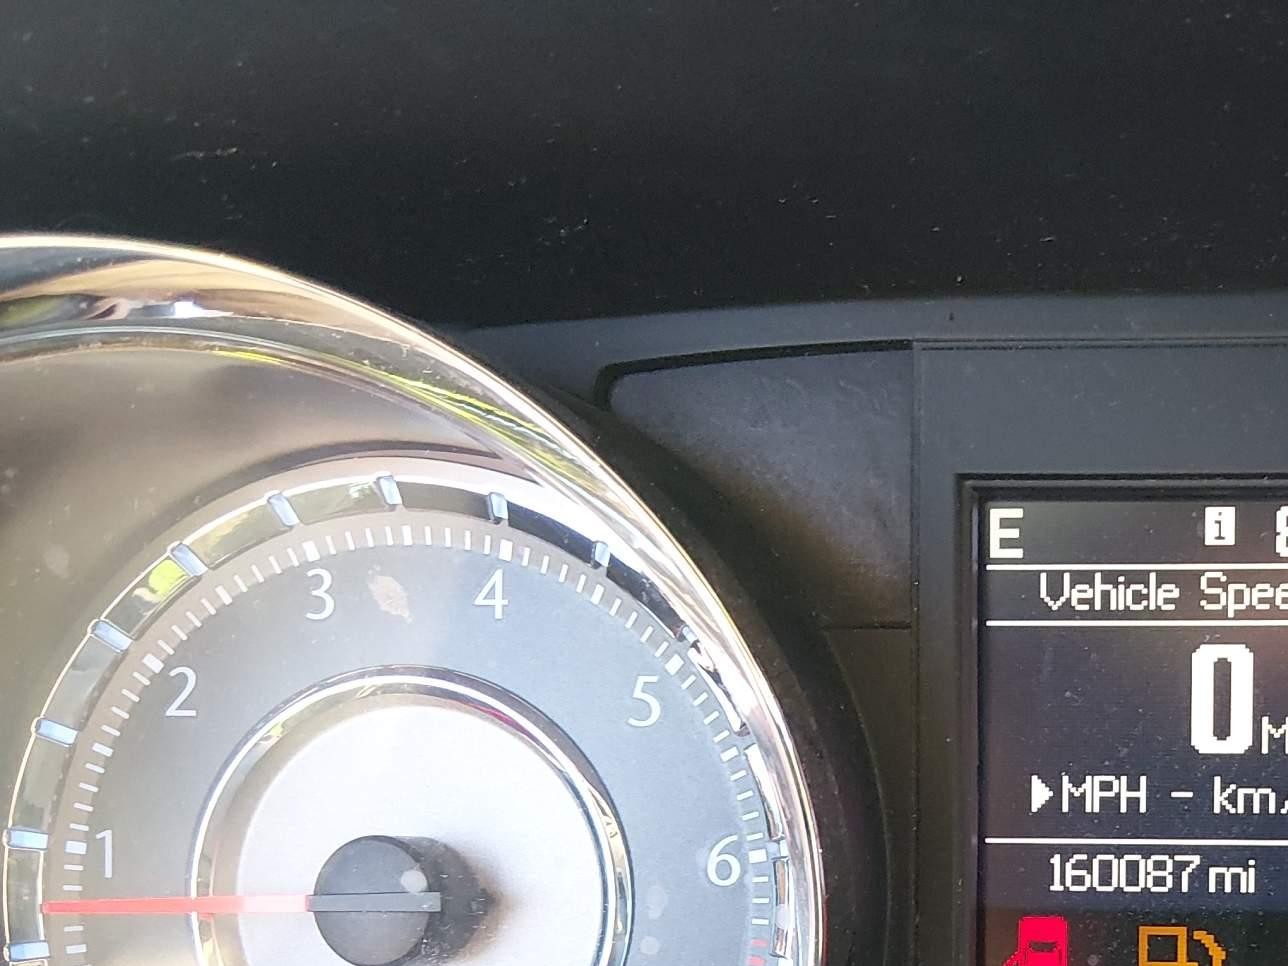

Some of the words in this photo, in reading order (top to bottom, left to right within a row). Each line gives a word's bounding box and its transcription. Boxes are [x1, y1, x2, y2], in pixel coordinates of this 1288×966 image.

[989, 508, 1024, 558] E
[306, 568, 334, 620] 3
[473, 569, 509, 620] 4
[1040, 572, 1180, 611] Vehicle
[164, 668, 197, 718] 2
[629, 674, 661, 727] 5
[1191, 644, 1253, 754] 0
[1061, 775, 1147, 813] MPH
[96, 831, 115, 879] 1
[707, 836, 742, 887] 6
[1049, 854, 1200, 893] 160087
[1208, 860, 1256, 893] mi
